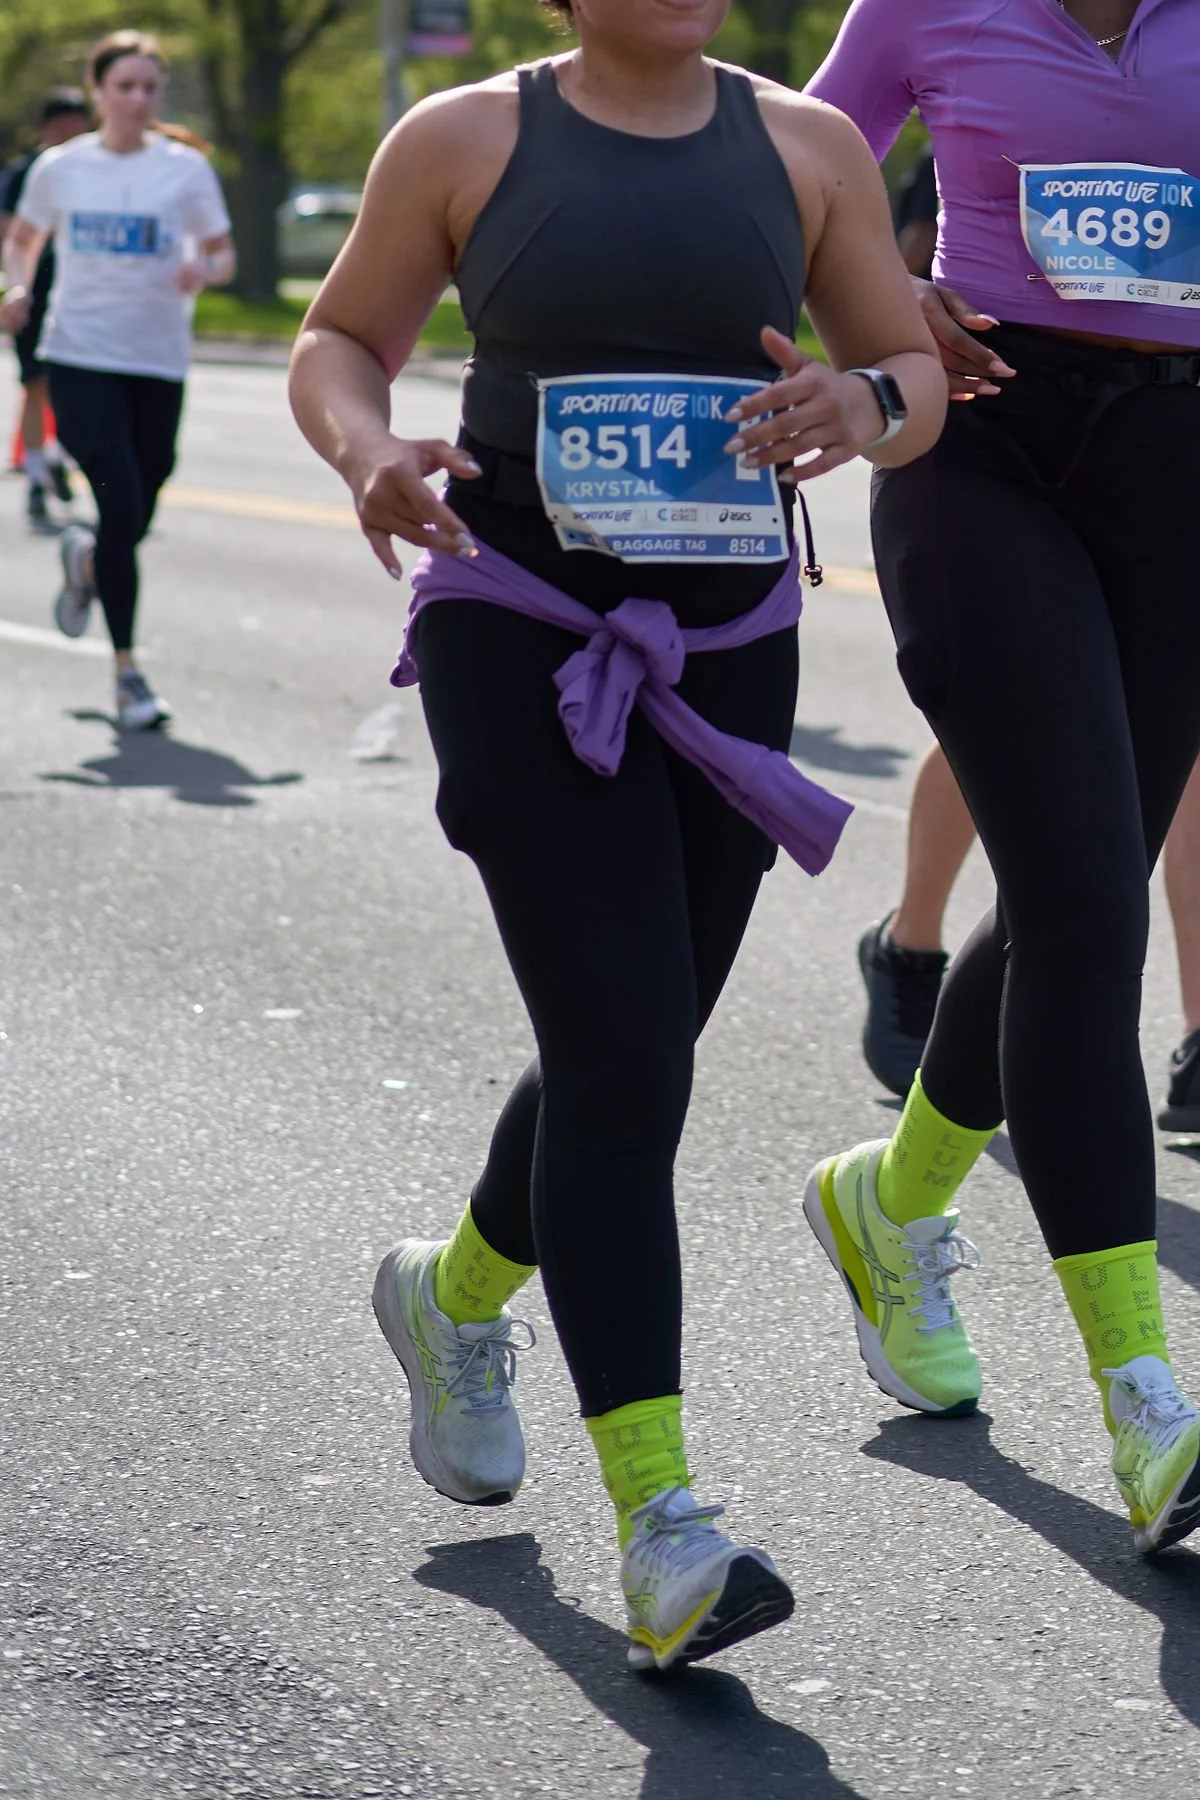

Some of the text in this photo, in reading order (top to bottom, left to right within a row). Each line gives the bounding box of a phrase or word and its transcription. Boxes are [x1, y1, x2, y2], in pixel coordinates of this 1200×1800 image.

[1162, 184, 1194, 208] 10K
[1041, 207, 1171, 249] 4689
[1046, 255, 1117, 271] NICOLE
[691, 394, 723, 421] 10K
[559, 424, 692, 471] 8514
[565, 479, 663, 499] KRYSTAL
[612, 538, 766, 555] BAGGAGE TAG 8514
